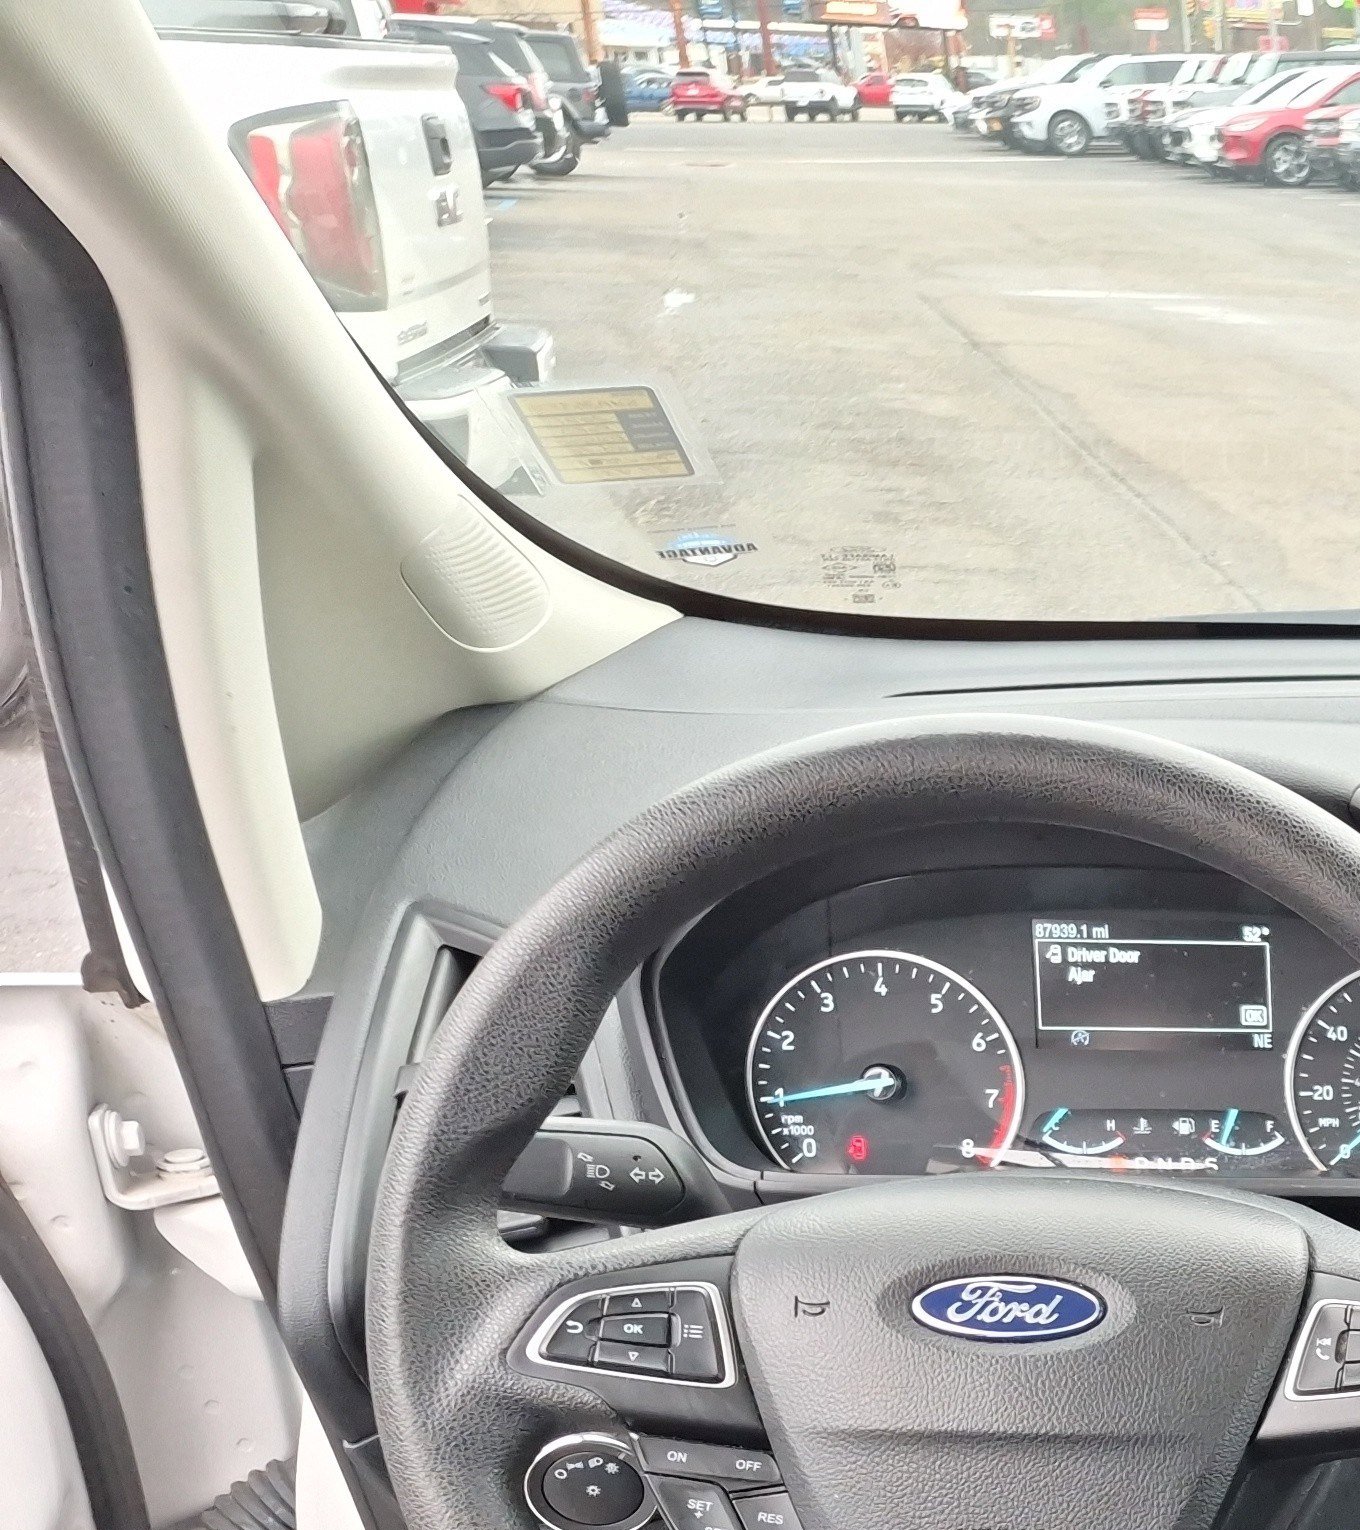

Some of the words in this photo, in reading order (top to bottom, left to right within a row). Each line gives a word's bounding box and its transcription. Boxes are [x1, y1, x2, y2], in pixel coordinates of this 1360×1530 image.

[1035, 923, 1088, 938] 87939.1
[1067, 946, 1107, 963] Driver
[1109, 947, 1141, 963] Door
[1067, 966, 1096, 985] Ajar
[874, 977, 887, 996] 4
[820, 993, 834, 1012] 3
[931, 994, 943, 1013] 5
[781, 1031, 795, 1050] 2
[1252, 1033, 1273, 1048] NE
[1327, 1026, 1348, 1041] 40
[972, 1032, 986, 1051] 6
[774, 1088, 785, 1107] 1
[984, 1089, 999, 1108] 7
[1312, 1085, 1333, 1100] 20
[781, 1114, 803, 1124] rpm
[1106, 1119, 1116, 1132] H
[1211, 1120, 1220, 1132] E
[1266, 1120, 1275, 1132] F
[1318, 1117, 1339, 1128] MPH
[782, 1125, 814, 1136] x1000
[803, 1138, 817, 1157] 0
[961, 1139, 975, 1158] 8
[947, 1281, 1063, 1324] Ford
[623, 1323, 644, 1334] OK
[667, 1450, 688, 1463] ON
[735, 1459, 762, 1472] OFF
[687, 1499, 714, 1512] SET
[757, 1512, 784, 1525] RES
